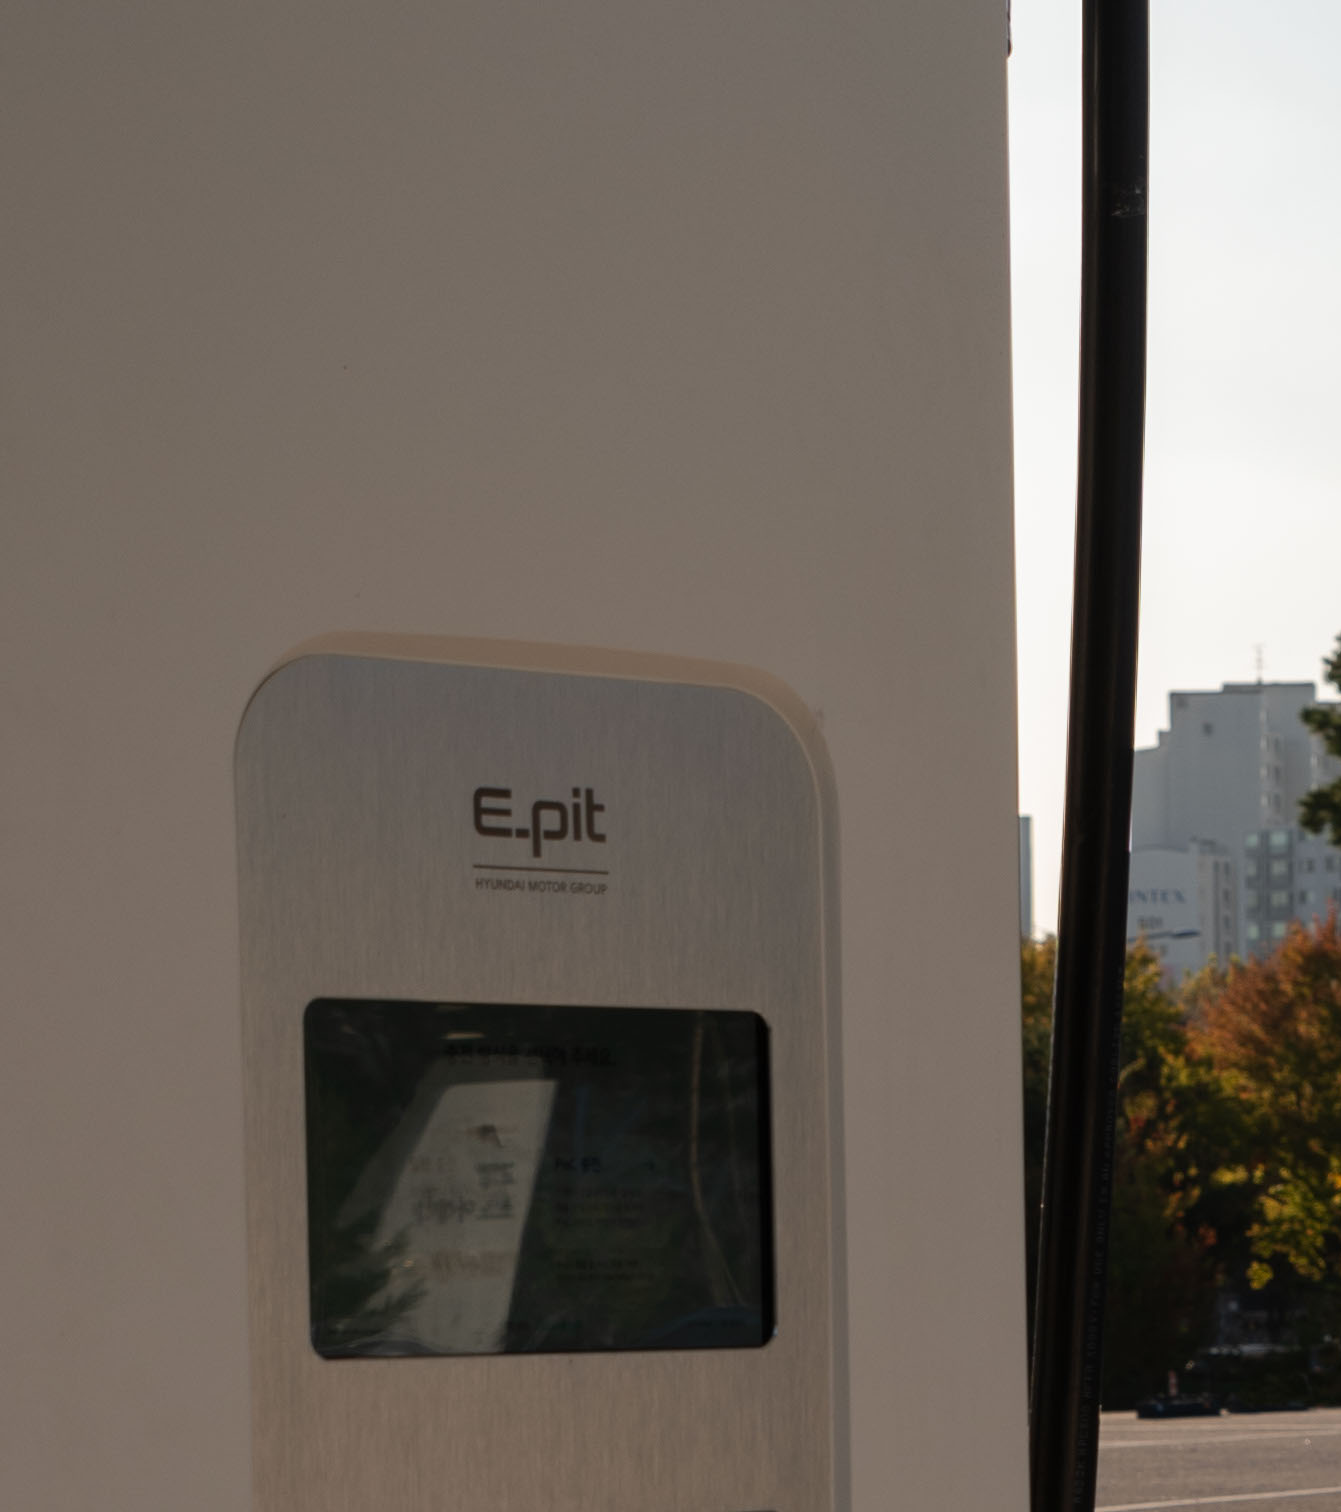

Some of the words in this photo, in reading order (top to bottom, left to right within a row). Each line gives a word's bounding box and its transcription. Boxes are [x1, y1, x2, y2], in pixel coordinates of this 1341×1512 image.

[475, 877, 526, 891] HYUNDAI
[528, 879, 568, 893] MOTOR
[570, 881, 608, 896] GROUP
[1128, 887, 1186, 904] INTEX
